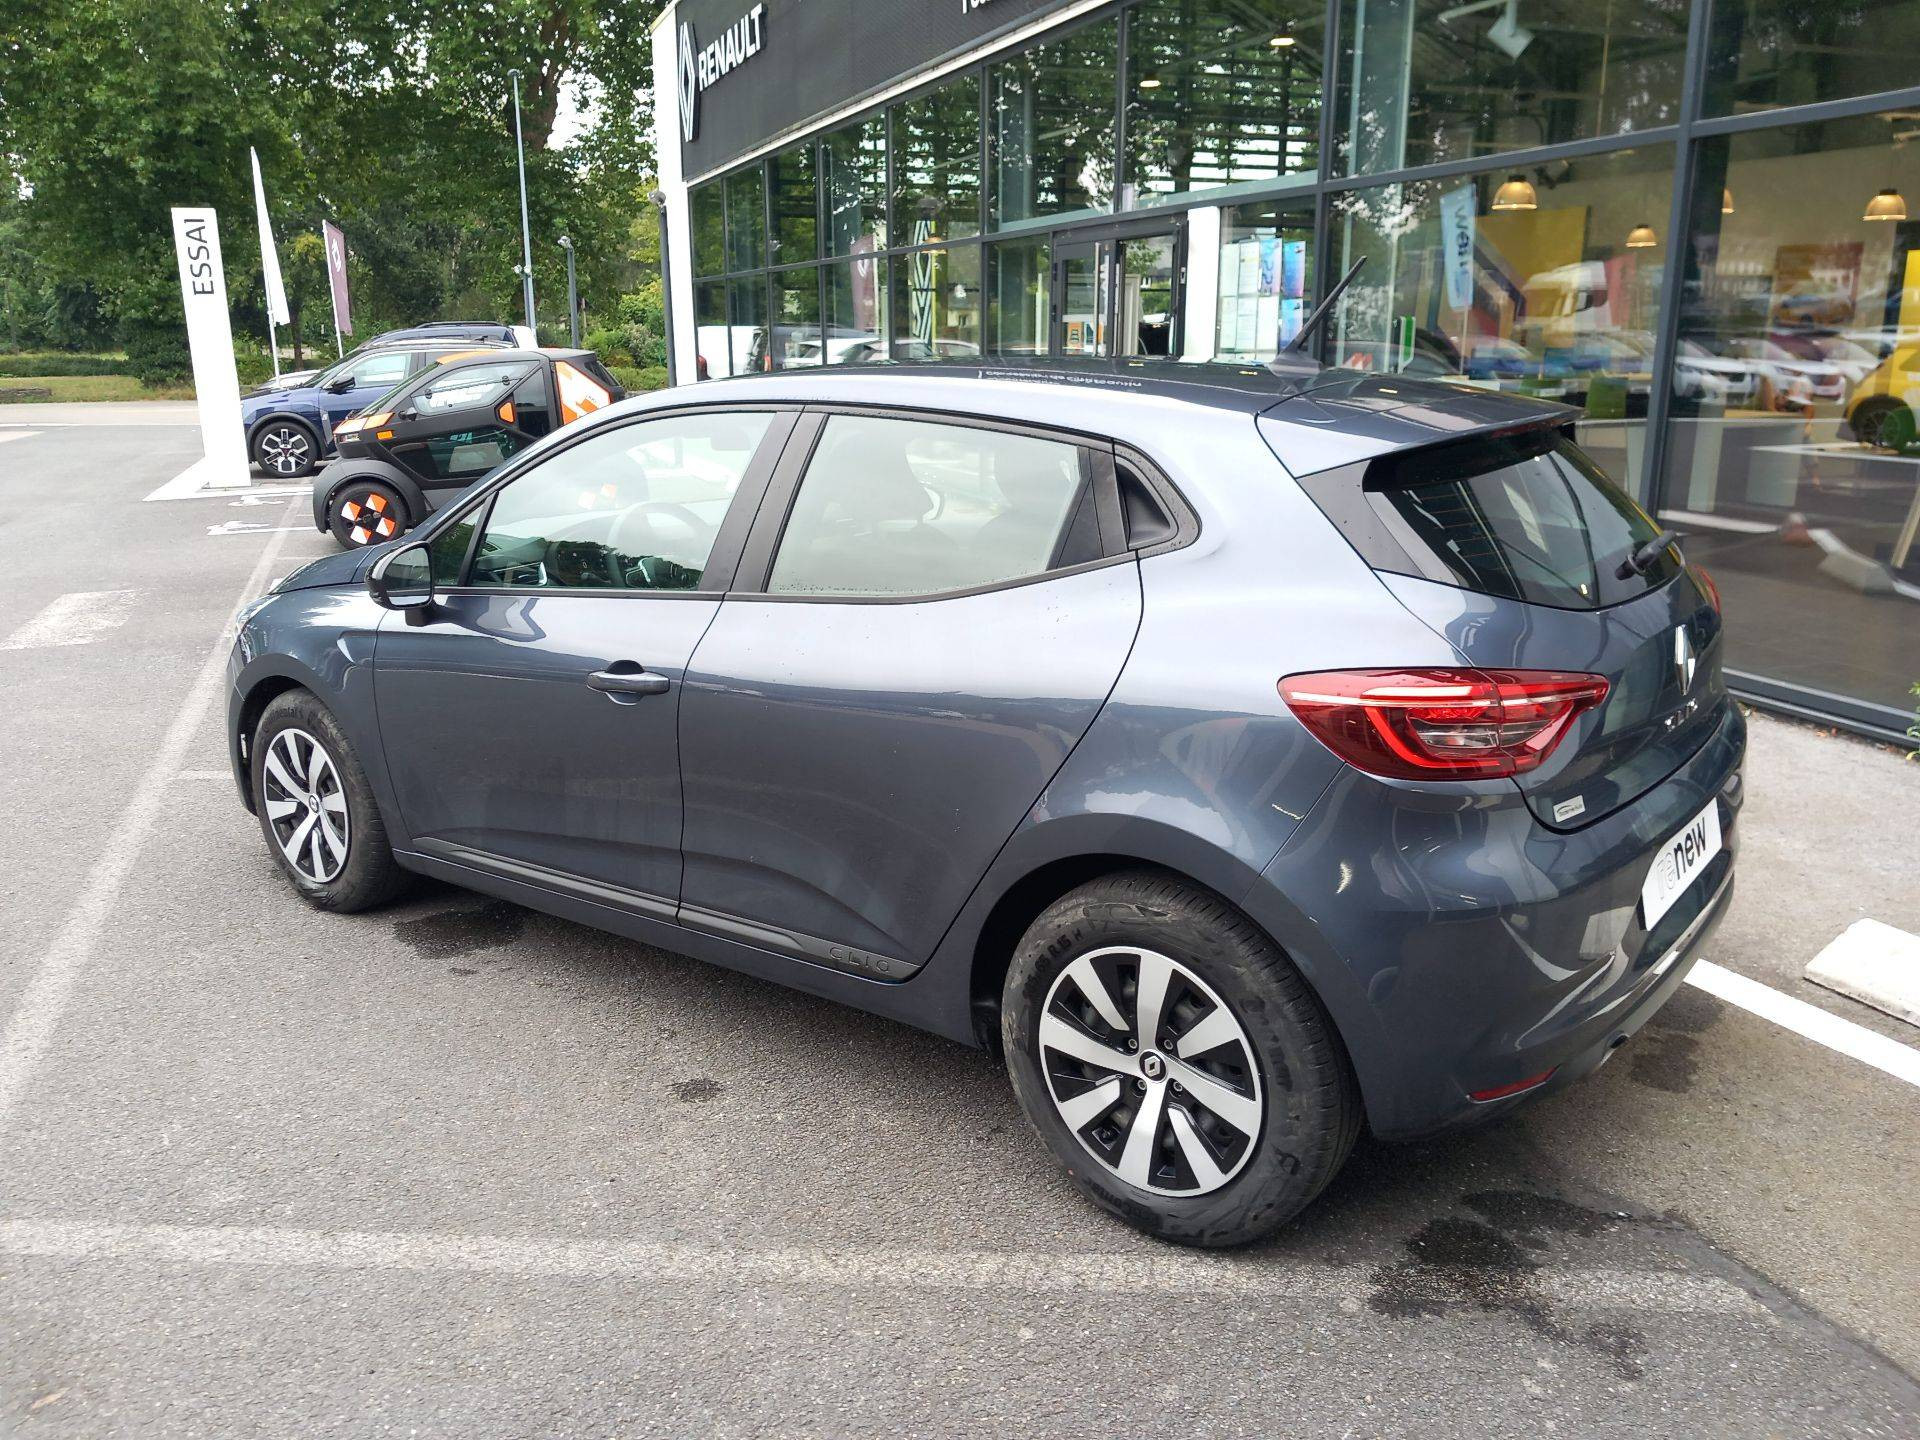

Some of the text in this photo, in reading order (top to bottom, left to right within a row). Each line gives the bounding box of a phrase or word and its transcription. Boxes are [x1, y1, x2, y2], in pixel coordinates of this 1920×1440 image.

[698, 3, 763, 92] RENAULT
[184, 219, 214, 295] ESSAI
[1656, 816, 1706, 901] renew
[829, 946, 890, 973] CLIO
